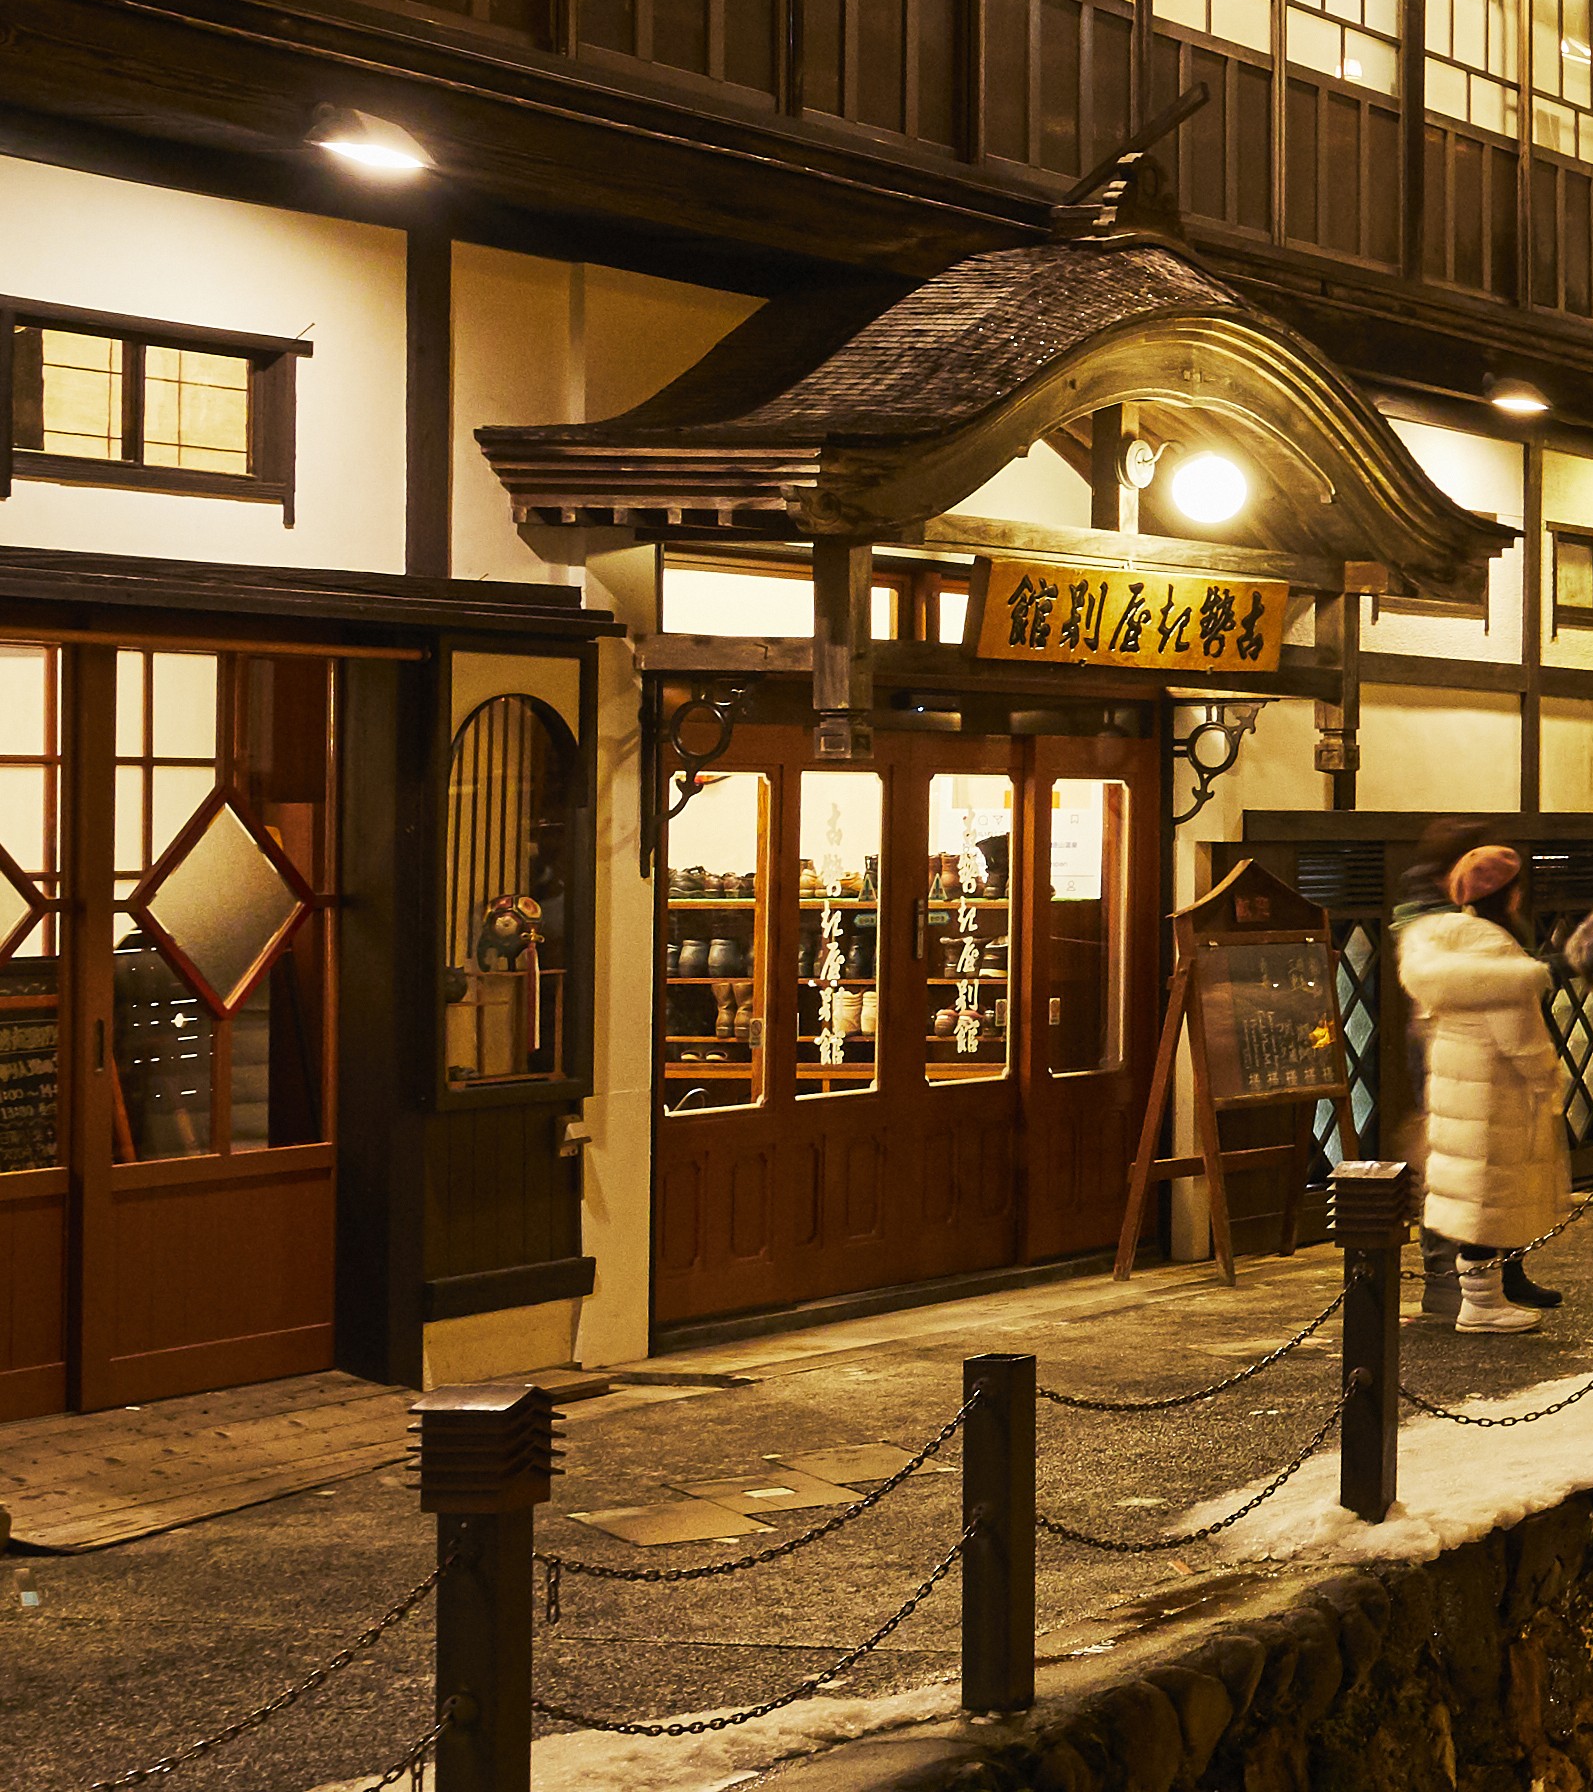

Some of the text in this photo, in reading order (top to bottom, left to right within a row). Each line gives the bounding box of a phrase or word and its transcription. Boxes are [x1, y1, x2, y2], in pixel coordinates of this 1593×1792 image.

[1006, 573, 1265, 661] 古勢起屋別館
